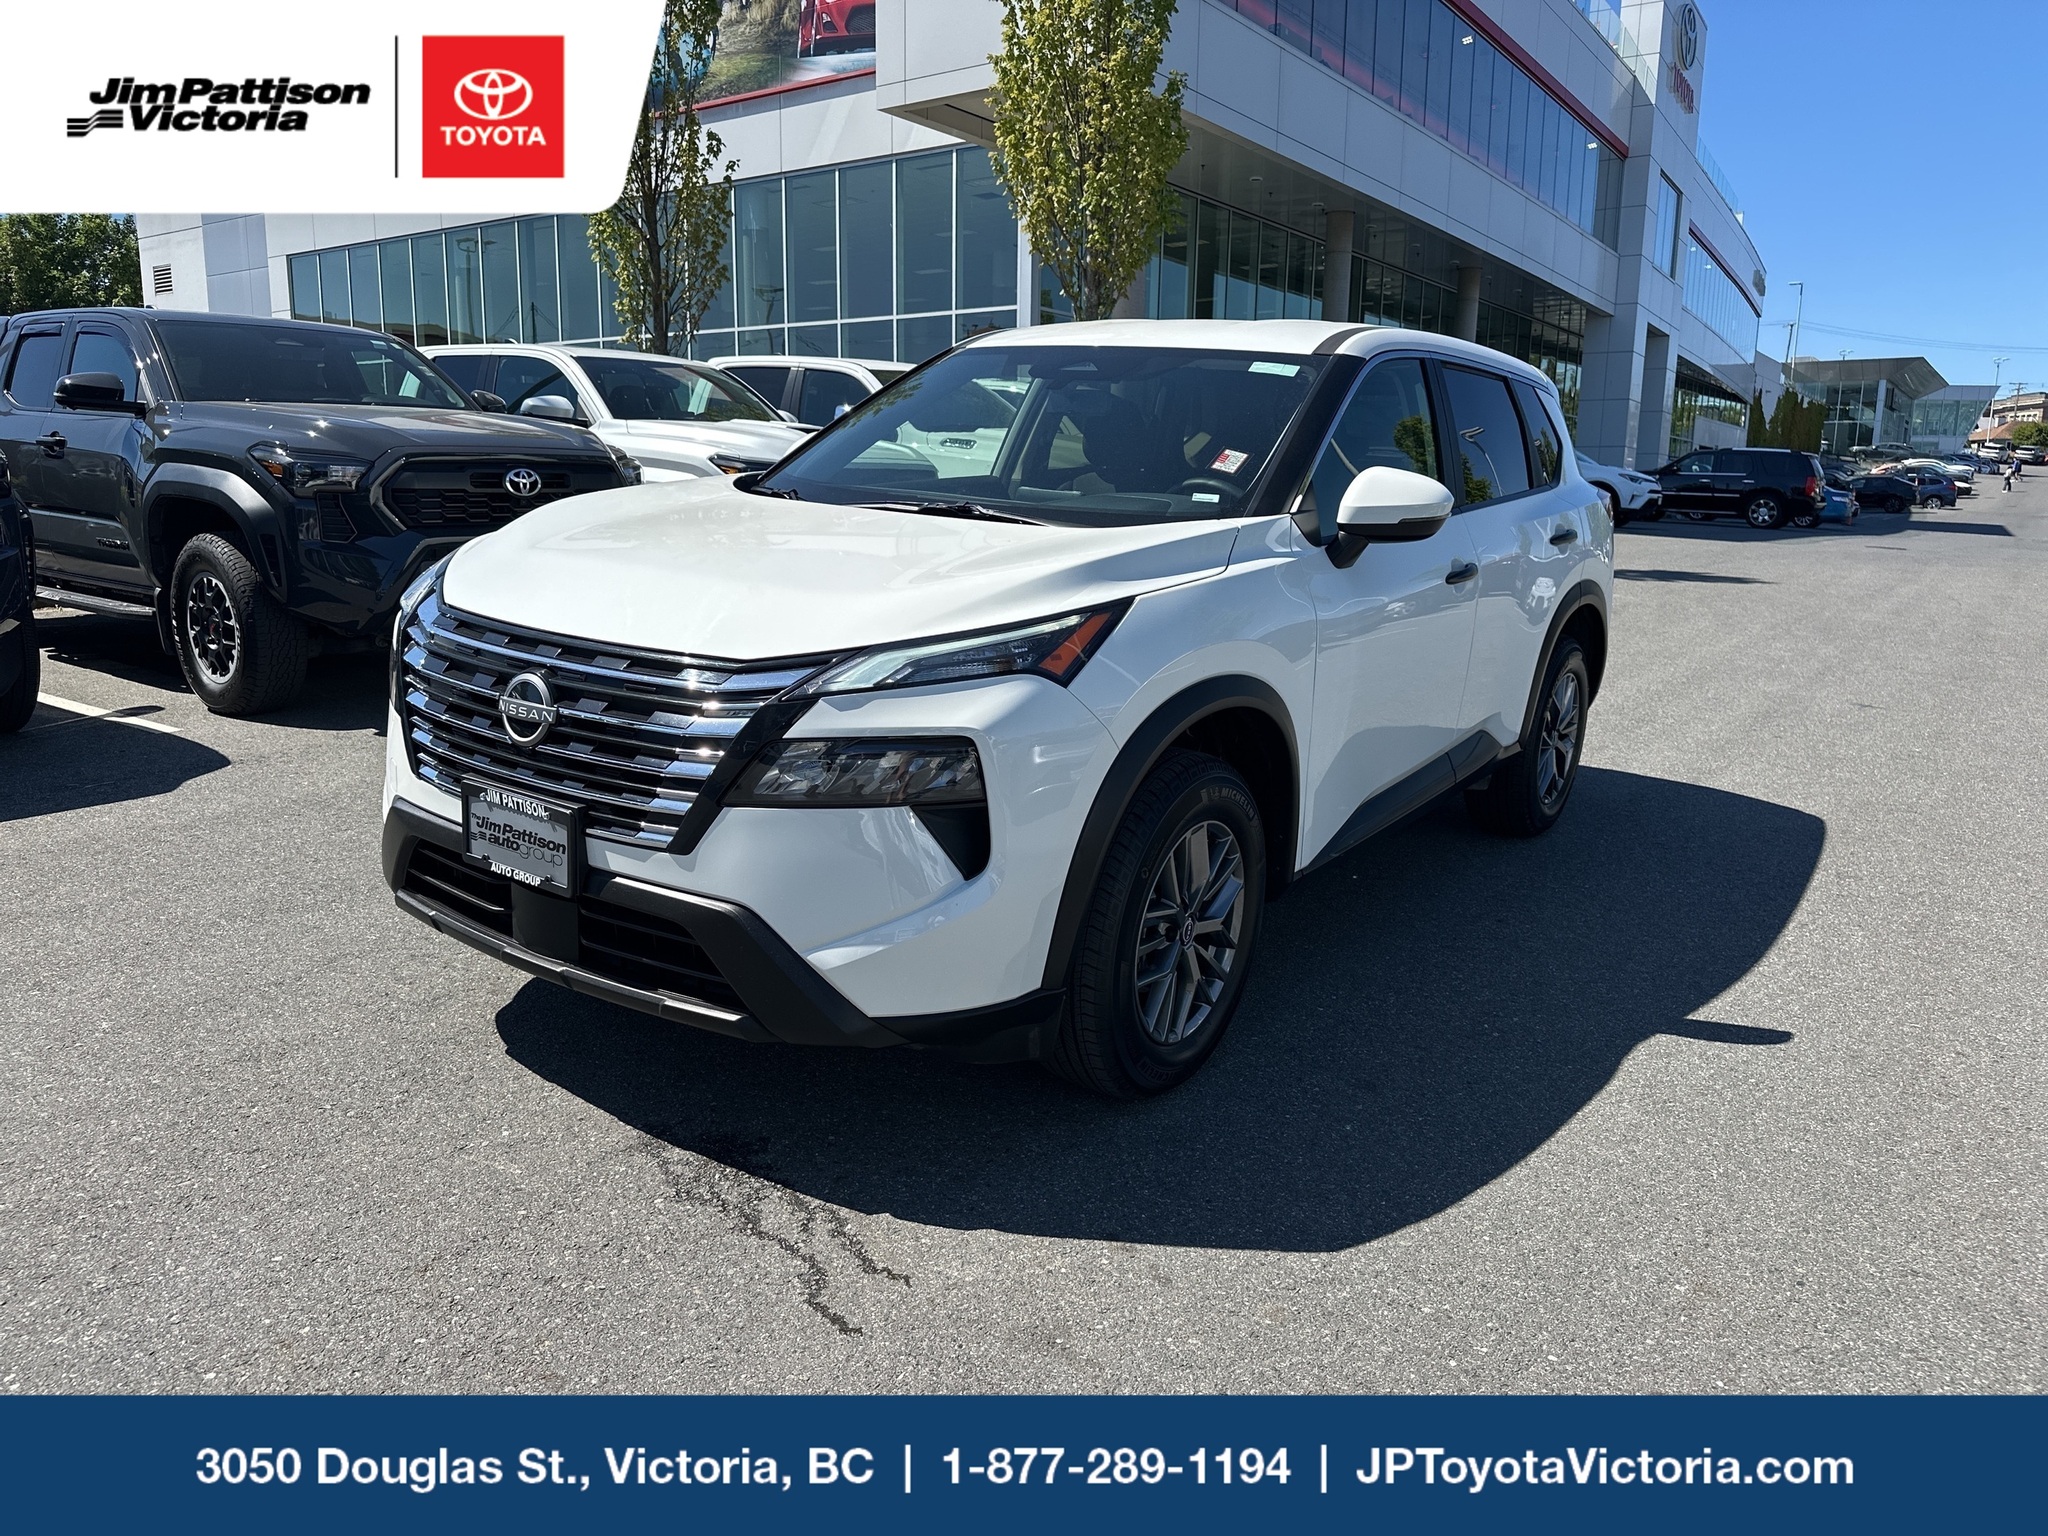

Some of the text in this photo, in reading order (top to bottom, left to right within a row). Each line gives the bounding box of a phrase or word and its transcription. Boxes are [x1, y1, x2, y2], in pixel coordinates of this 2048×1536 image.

[499, 699, 554, 722] NISSAN
[486, 788, 545, 818] JIM PATTISON
[491, 862, 541, 887] AUTO GROUP
